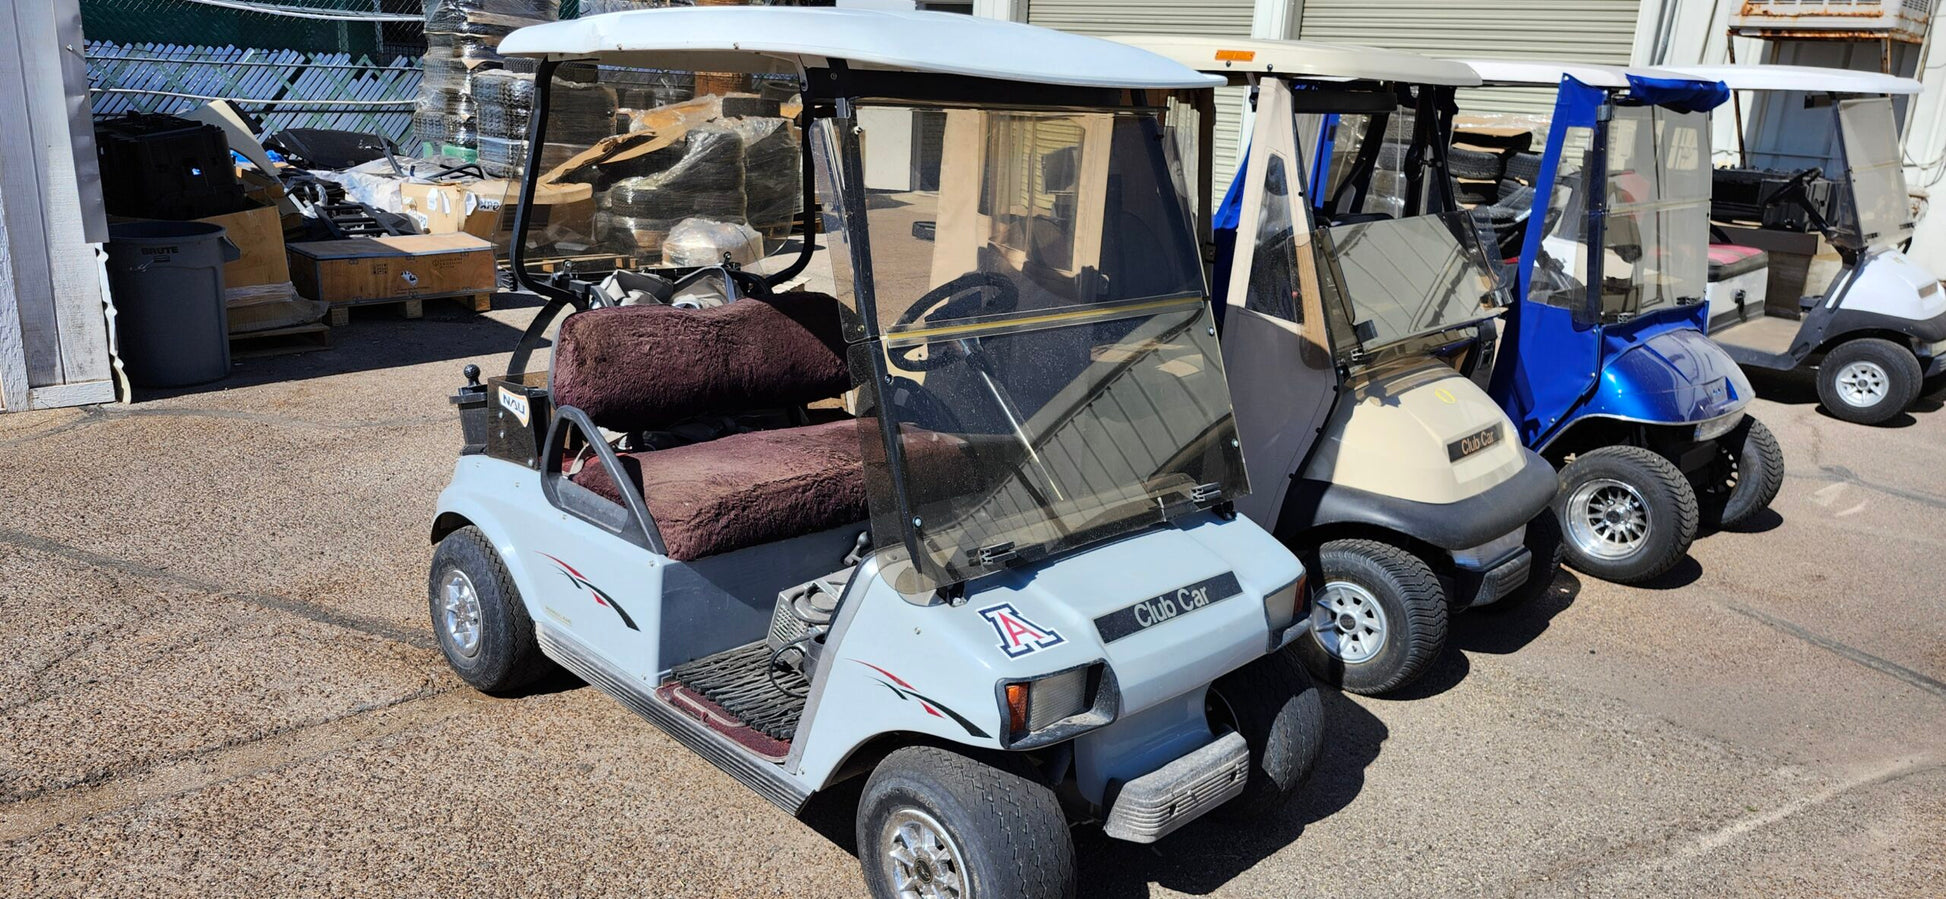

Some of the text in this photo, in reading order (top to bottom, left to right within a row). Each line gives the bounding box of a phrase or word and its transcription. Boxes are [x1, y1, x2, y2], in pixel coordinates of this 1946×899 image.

[141, 246, 179, 255] BRUTE
[503, 394, 526, 415] NAU
[1461, 431, 1494, 455] Club Car
[1134, 586, 1209, 627] Club Car
[977, 602, 1066, 659] A
